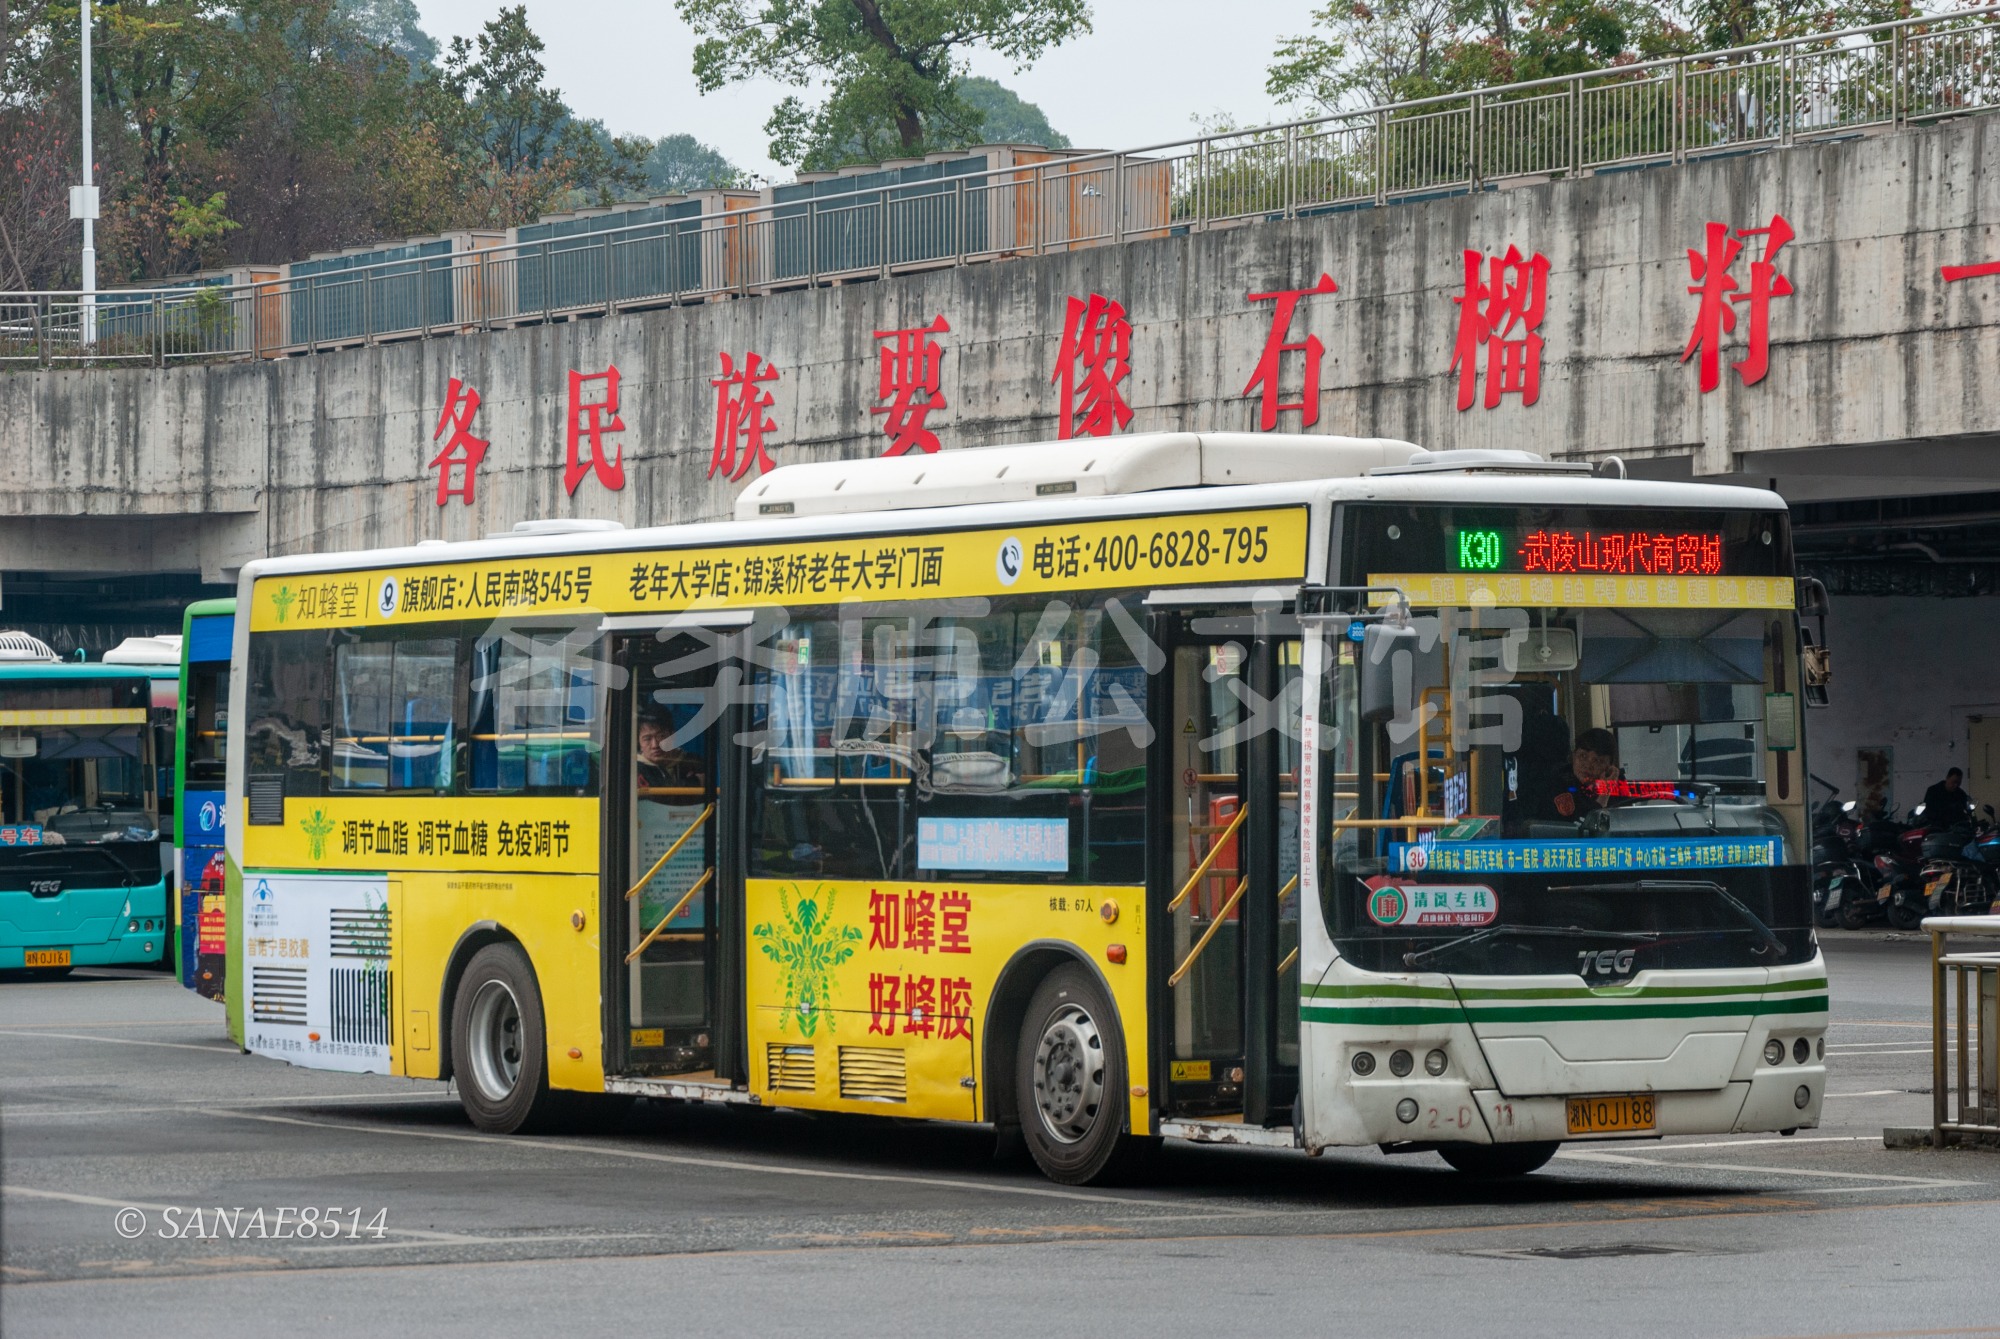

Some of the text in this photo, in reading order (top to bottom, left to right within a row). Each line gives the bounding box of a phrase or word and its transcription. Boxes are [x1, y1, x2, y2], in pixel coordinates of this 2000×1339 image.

[1033, 525, 1269, 580] 电话:400-6828-795
[1460, 531, 1500, 569] K30
[297, 583, 359, 620] 知蜂堂
[401, 566, 592, 612] 旗舰店:人民南路545号
[342, 820, 571, 858] 调节血脂 调节血糖 免疫调节
[1410, 852, 1424, 868] 30
[30, 880, 61, 893] TEG
[1414, 891, 1487, 908] 清风专线
[868, 889, 972, 955] 知蜂堂
[1578, 949, 1636, 975] TEG
[868, 972, 973, 1041] 好蜂胶
